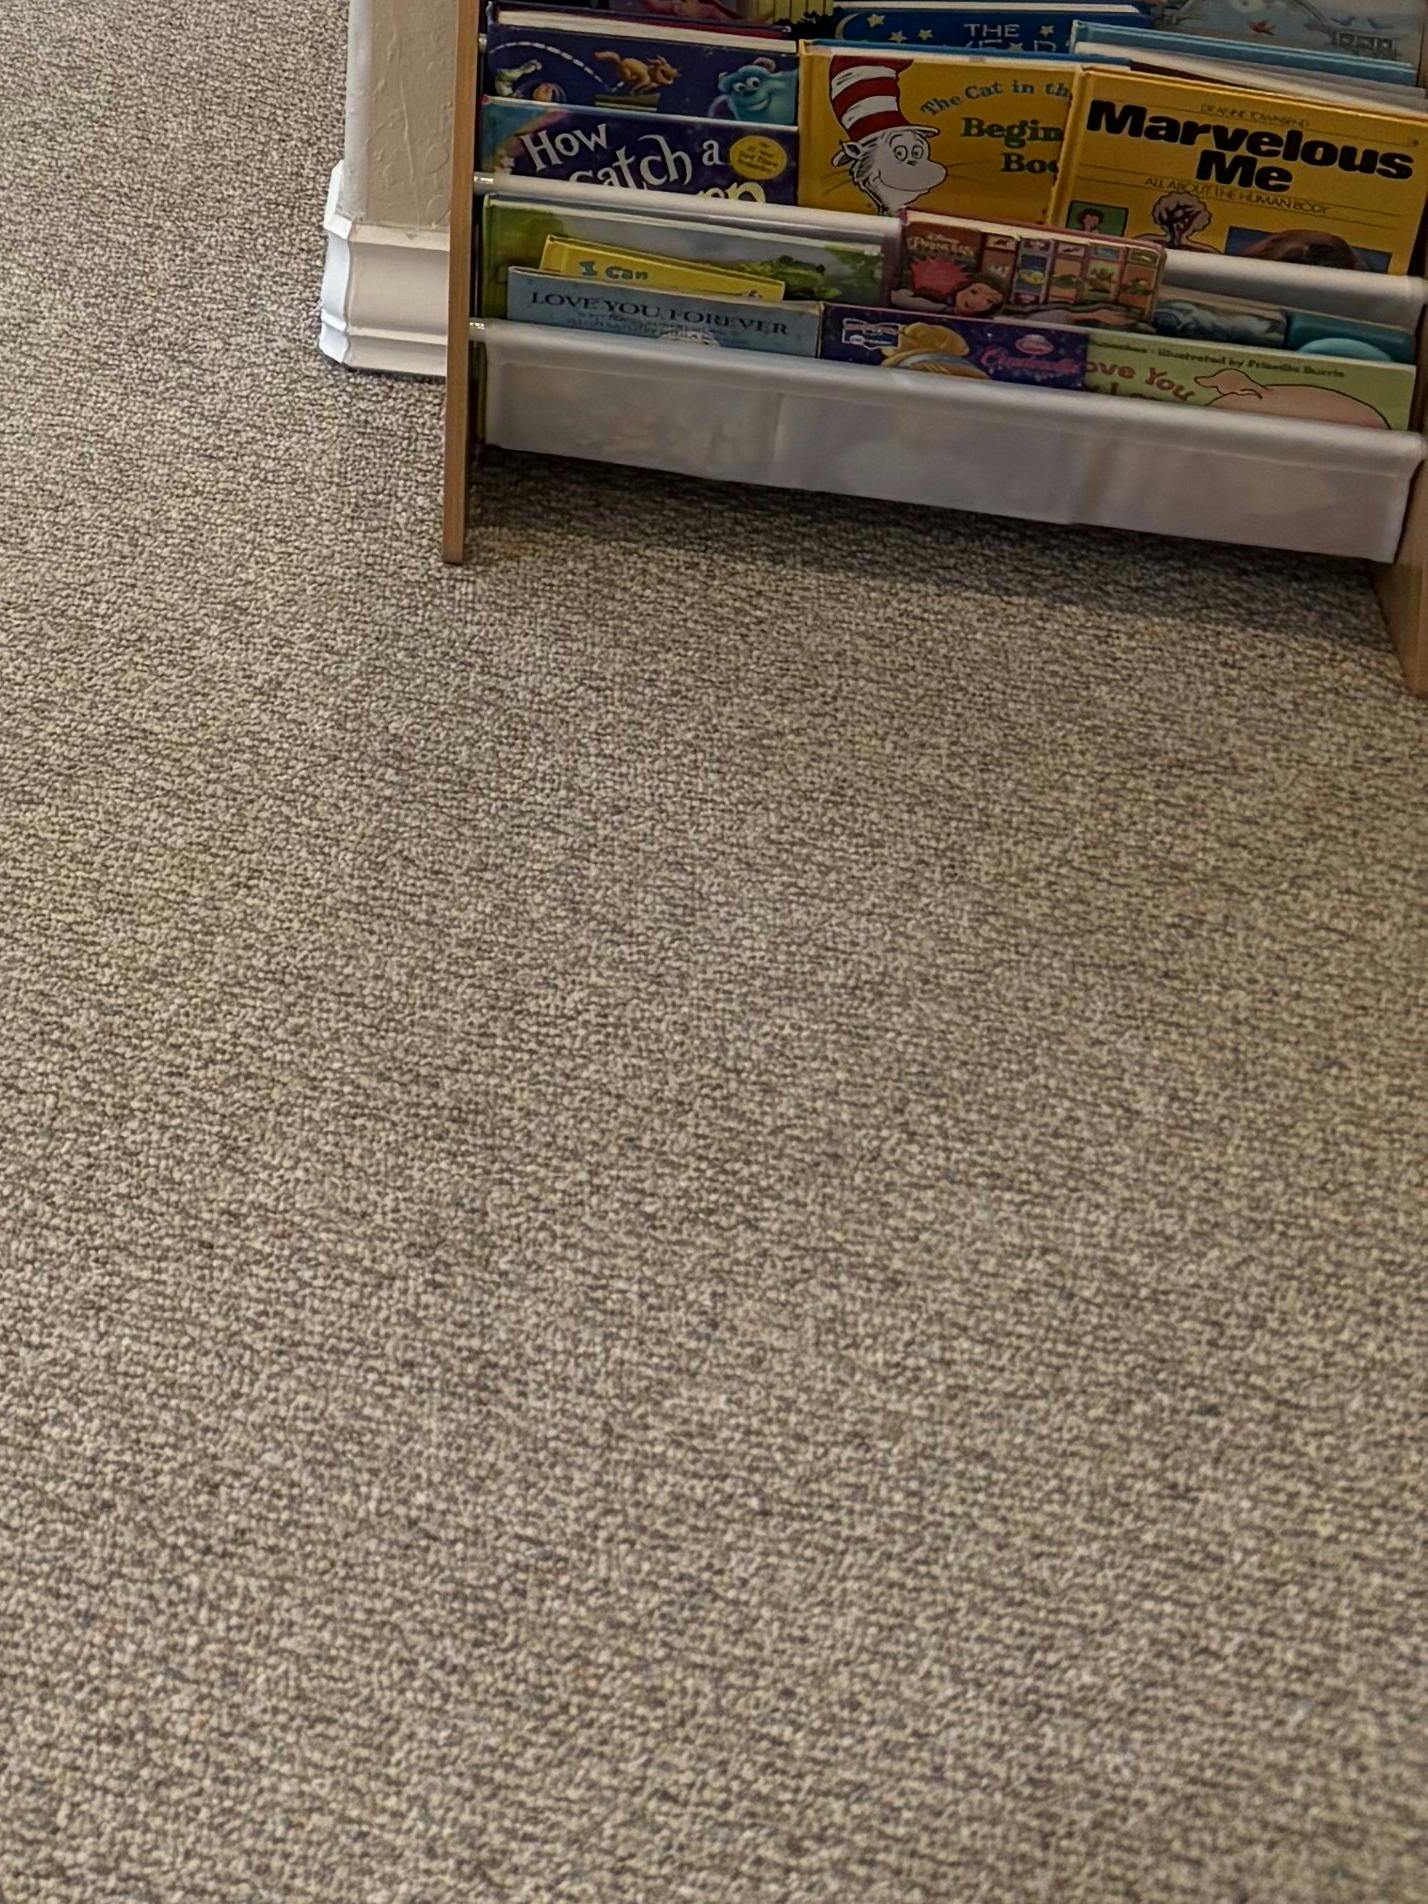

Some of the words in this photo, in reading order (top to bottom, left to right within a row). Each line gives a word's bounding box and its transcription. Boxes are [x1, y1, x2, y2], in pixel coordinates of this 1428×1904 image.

[964, 23, 1020, 38] THE
[920, 94, 962, 117] The
[964, 81, 1004, 100] Cat
[1012, 79, 1035, 95] in
[1045, 80, 1071, 99] th
[519, 122, 611, 174] How
[961, 116, 1065, 149] Begin
[1086, 100, 1414, 180] Marvelous
[701, 138, 727, 167] a
[1195, 148, 1293, 192] Me
[1145, 176, 1168, 189] ALL
[1170, 179, 1212, 197] ABOUT
[1238, 190, 1293, 210] HUMAN
[1294, 199, 1330, 214] BODY
[605, 263, 649, 281] Can
[530, 291, 599, 310] LOVE
[603, 299, 662, 319] YOU
[669, 306, 789, 337] FOREVER
[1145, 367, 1195, 403] You
